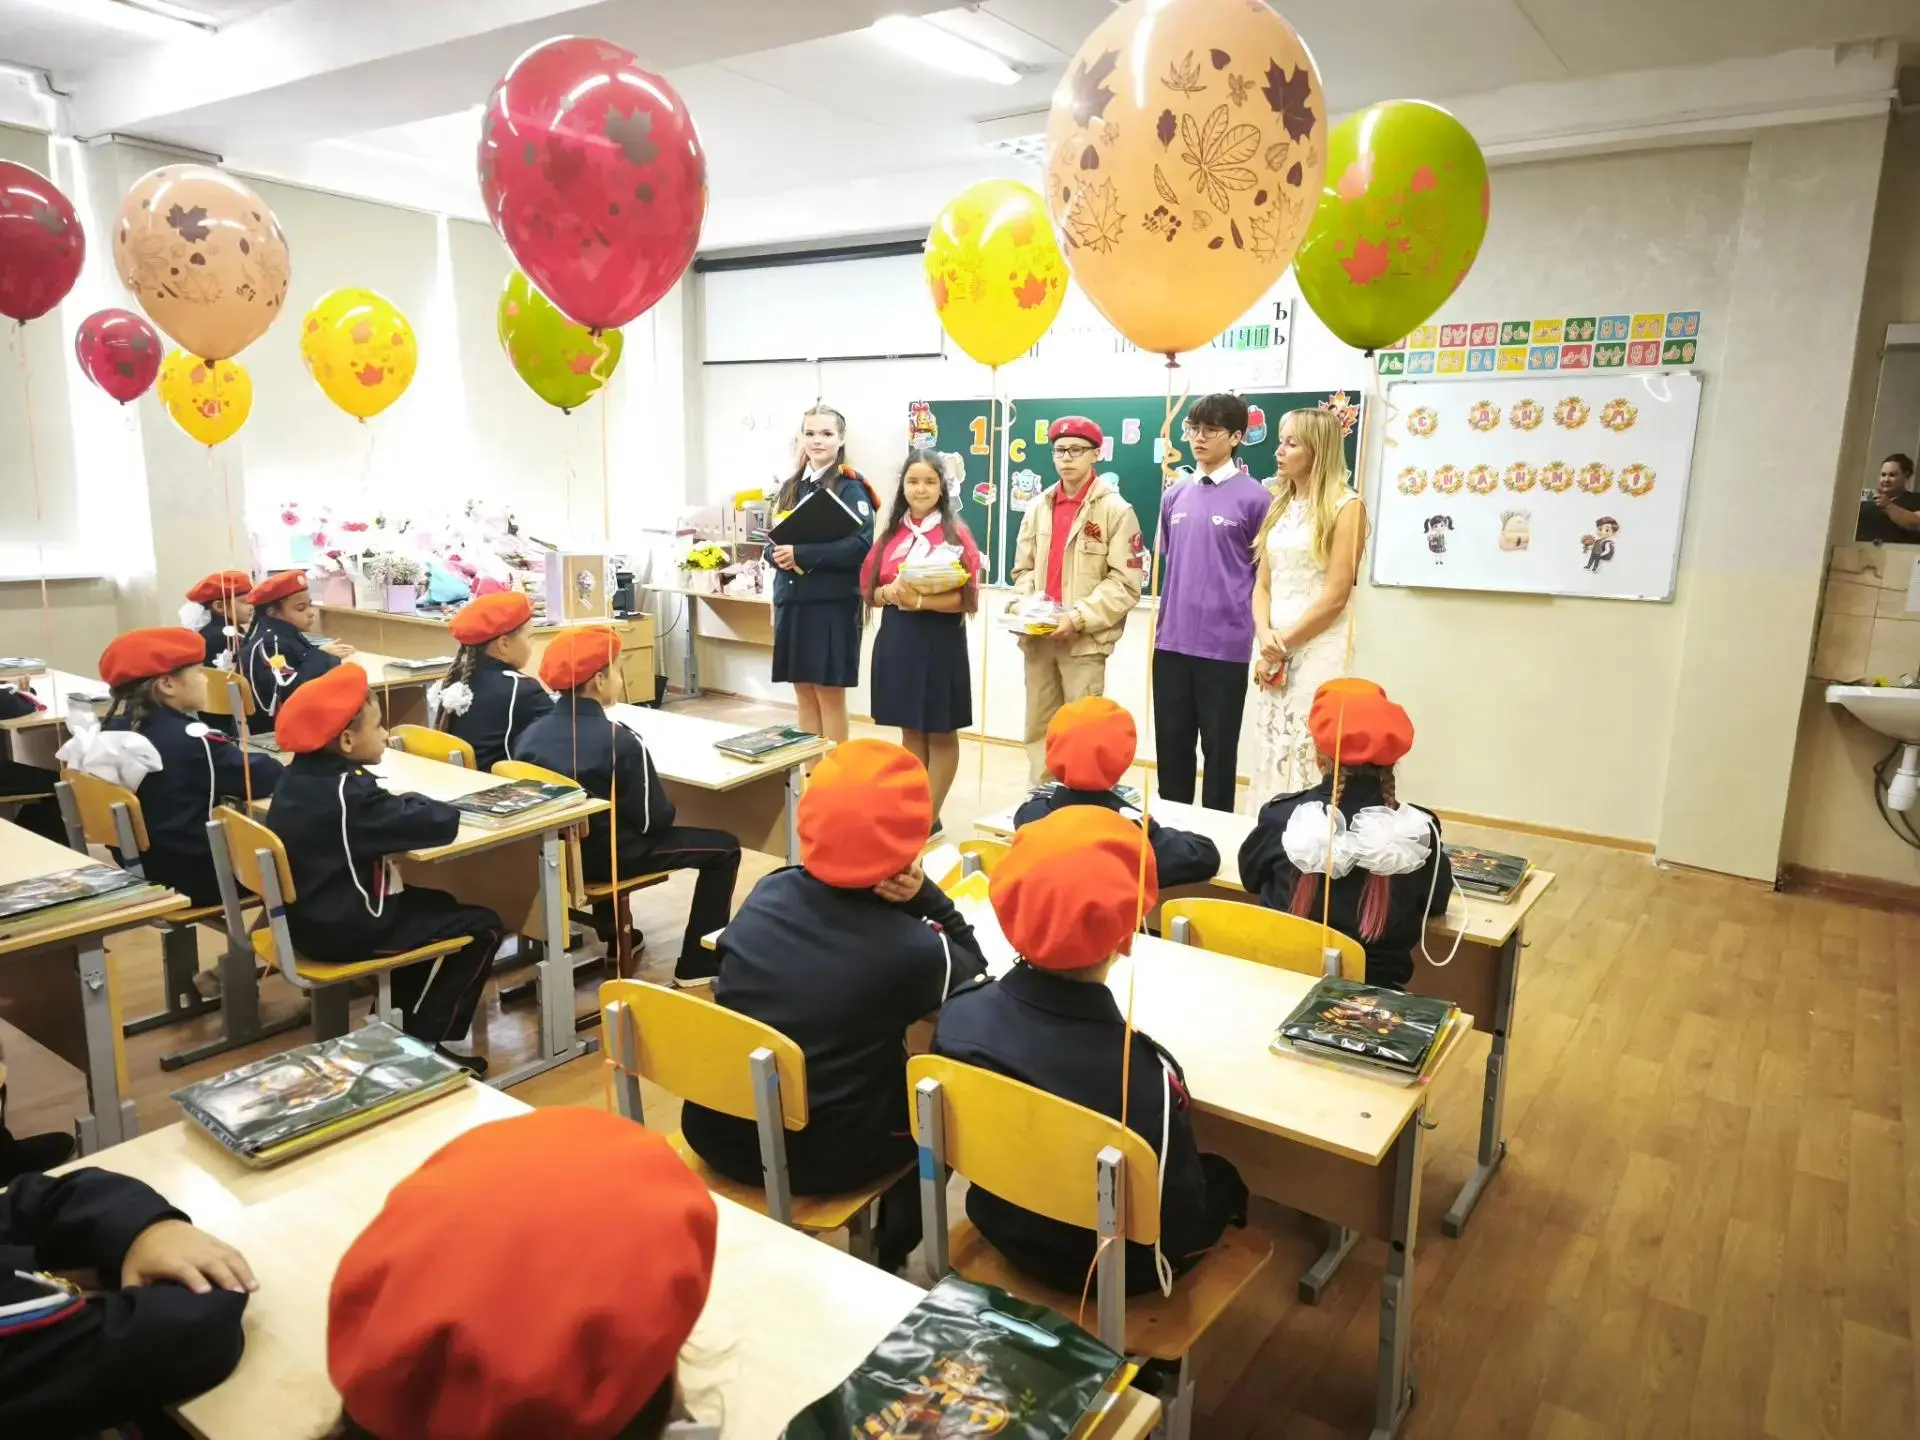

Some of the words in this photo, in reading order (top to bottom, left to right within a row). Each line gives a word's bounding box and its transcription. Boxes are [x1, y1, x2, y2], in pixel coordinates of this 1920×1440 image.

[1273, 301, 1288, 321] Ъ
[1273, 327, 1286, 346] Ь
[969, 415, 990, 455] 1
